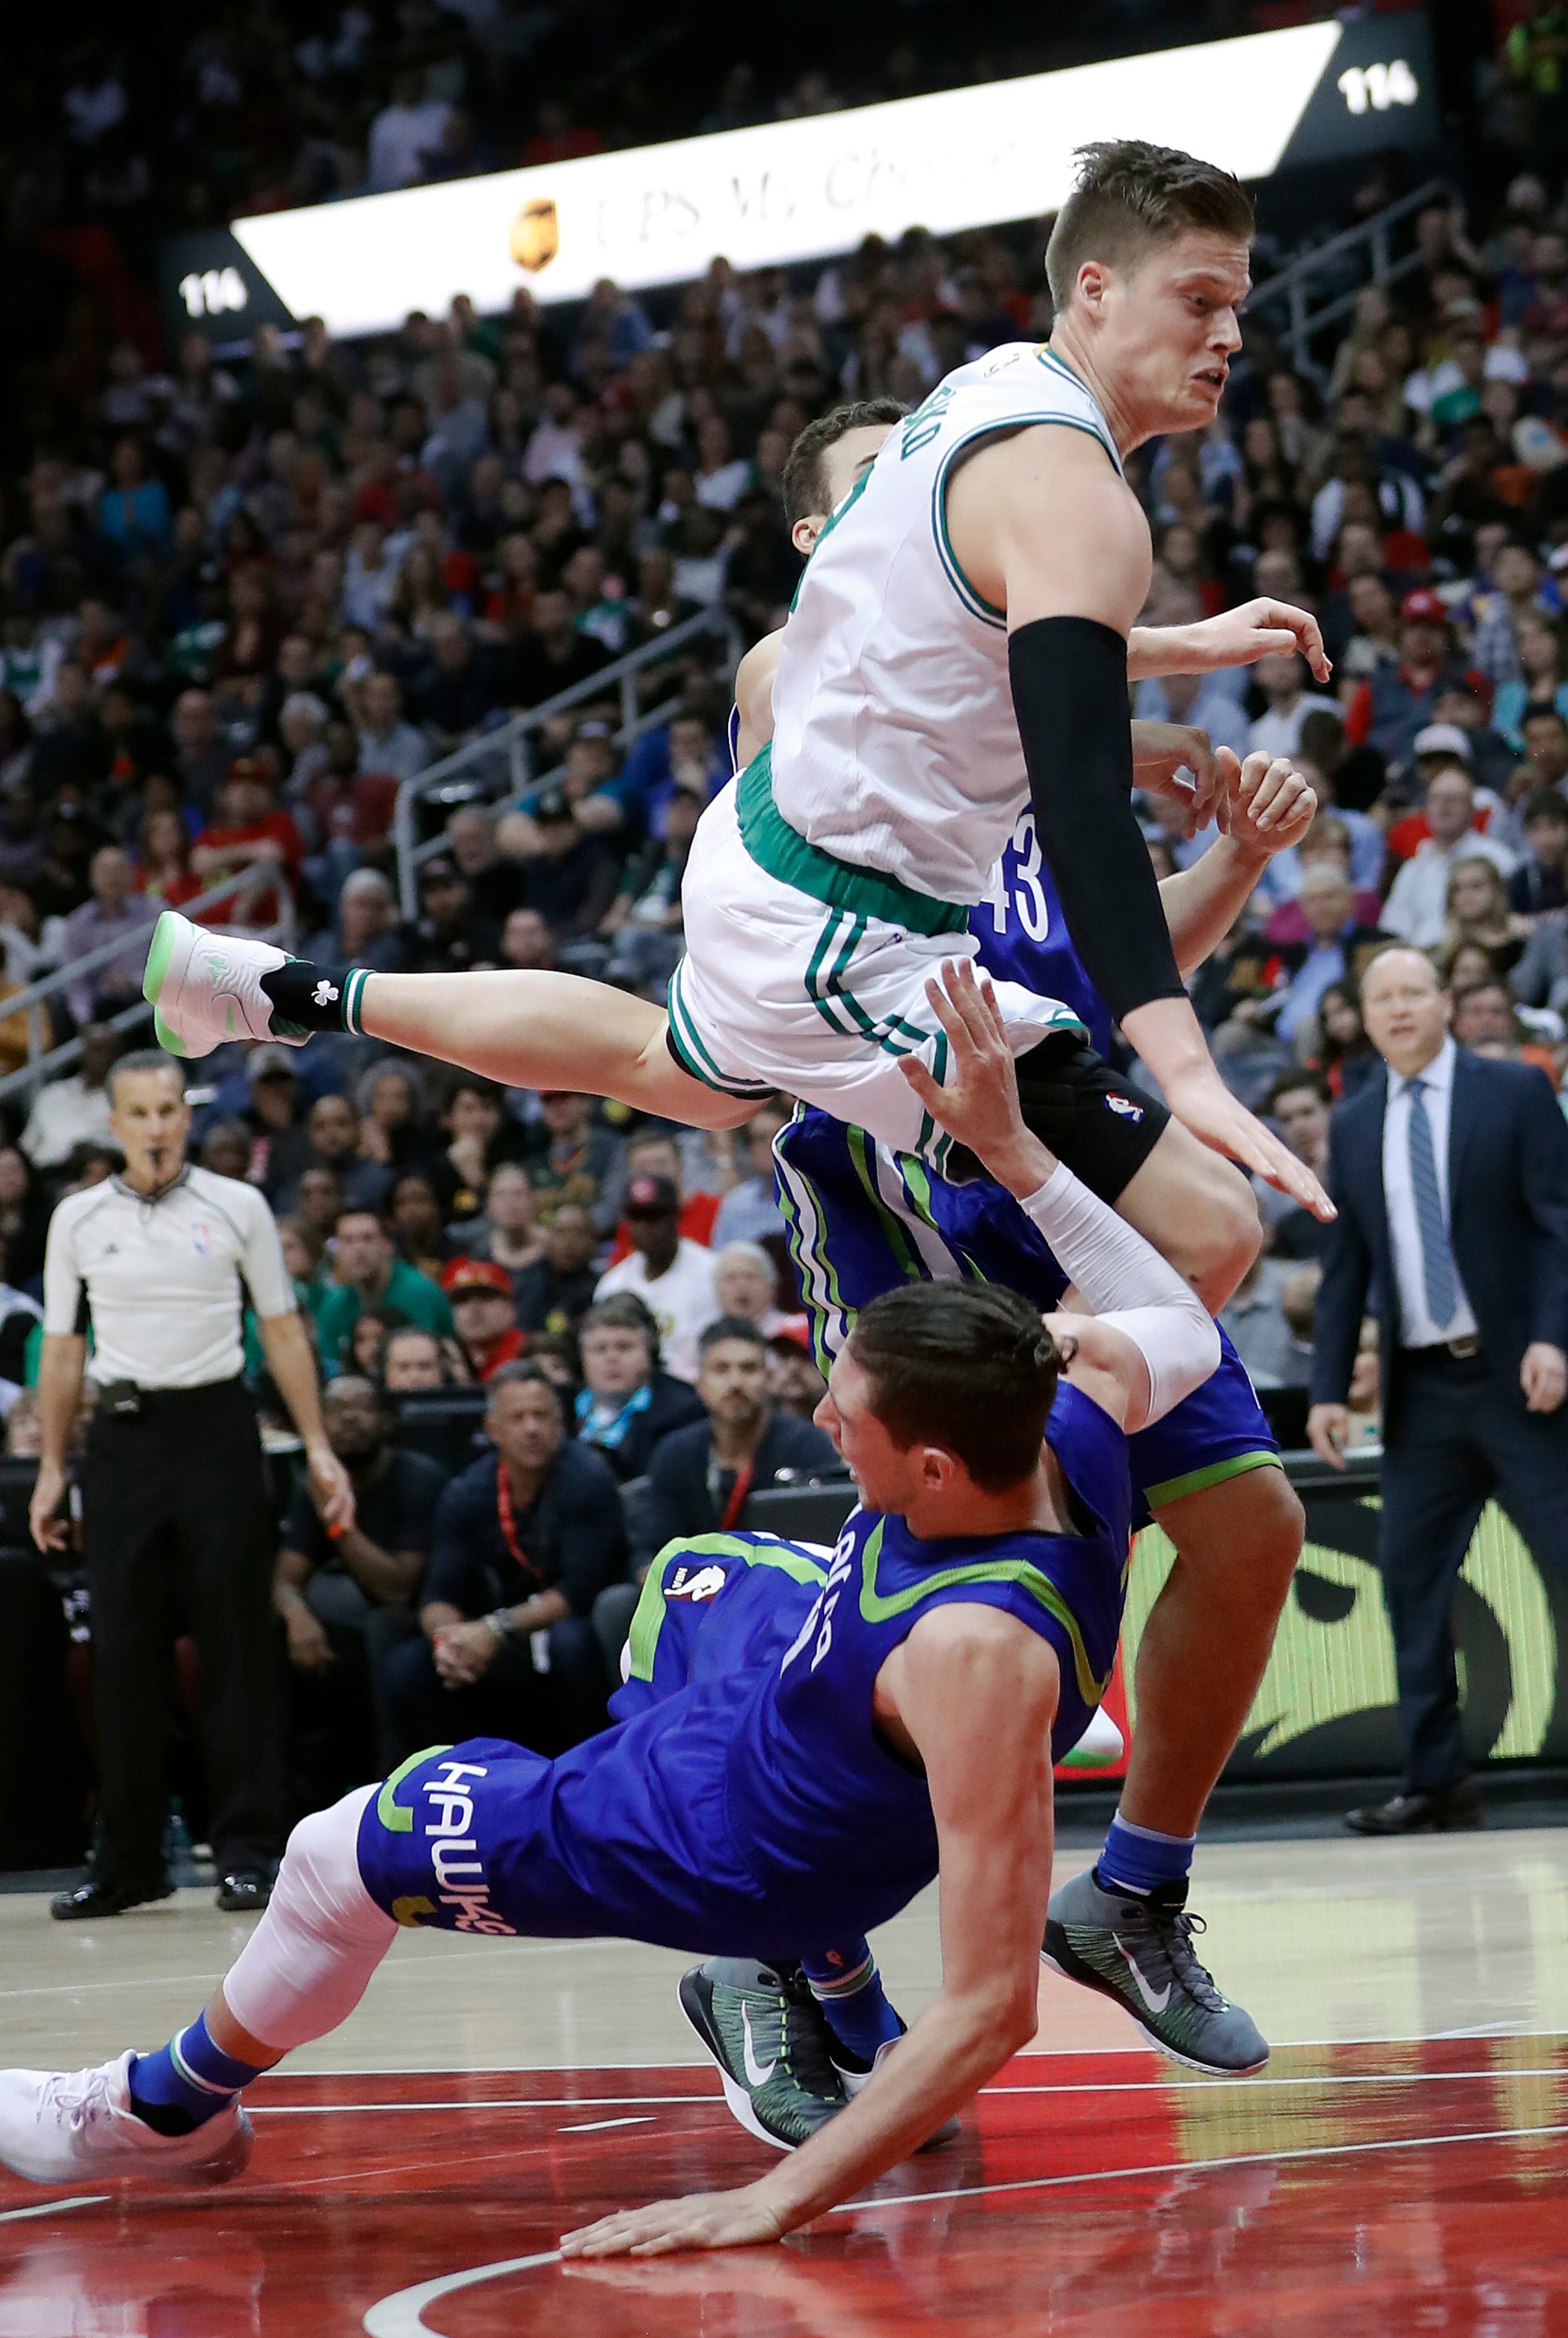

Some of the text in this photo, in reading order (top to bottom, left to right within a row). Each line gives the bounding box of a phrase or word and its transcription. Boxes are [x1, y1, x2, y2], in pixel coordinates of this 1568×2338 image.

[1337, 59, 1419, 115] 114
[178, 267, 249, 318] 114
[979, 813, 1049, 942] 43
[672, 1567, 688, 1588] NBA
[422, 1761, 517, 1935] HAWKS
